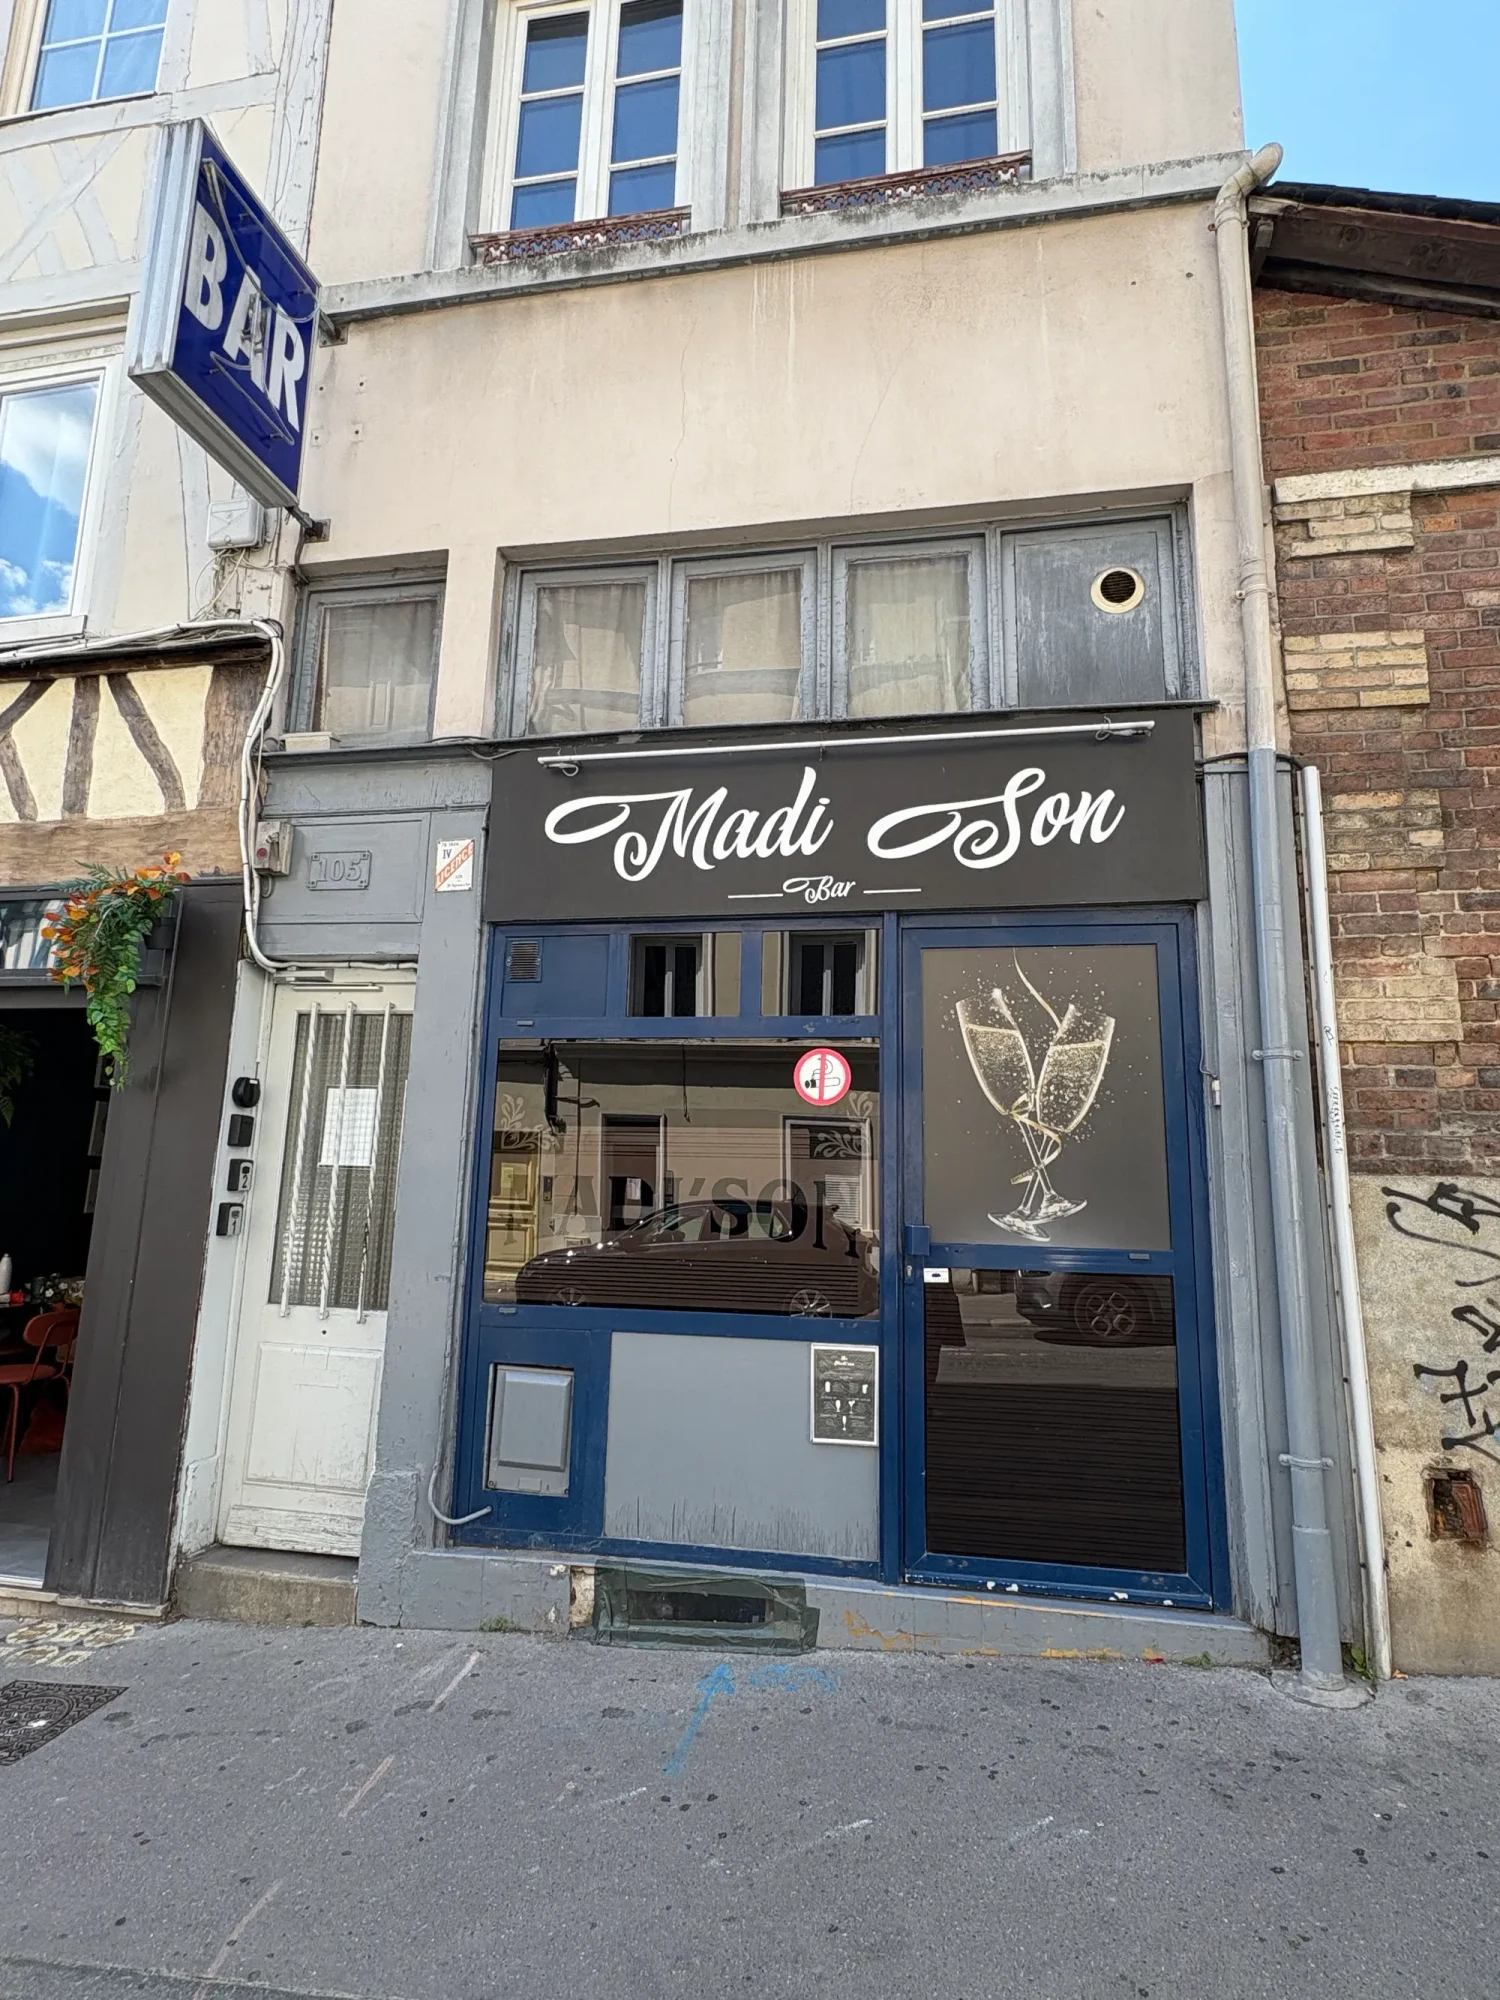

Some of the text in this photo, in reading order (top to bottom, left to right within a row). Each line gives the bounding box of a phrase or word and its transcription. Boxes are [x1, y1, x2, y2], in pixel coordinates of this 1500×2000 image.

[184, 202, 306, 431] BAR
[545, 766, 1126, 882] Madi Son
[435, 841, 474, 888] LICENCE
[442, 849, 453, 860] IV
[317, 857, 362, 882] 105
[782, 875, 857, 904] Bar
[241, 1174, 249, 1189] 2
